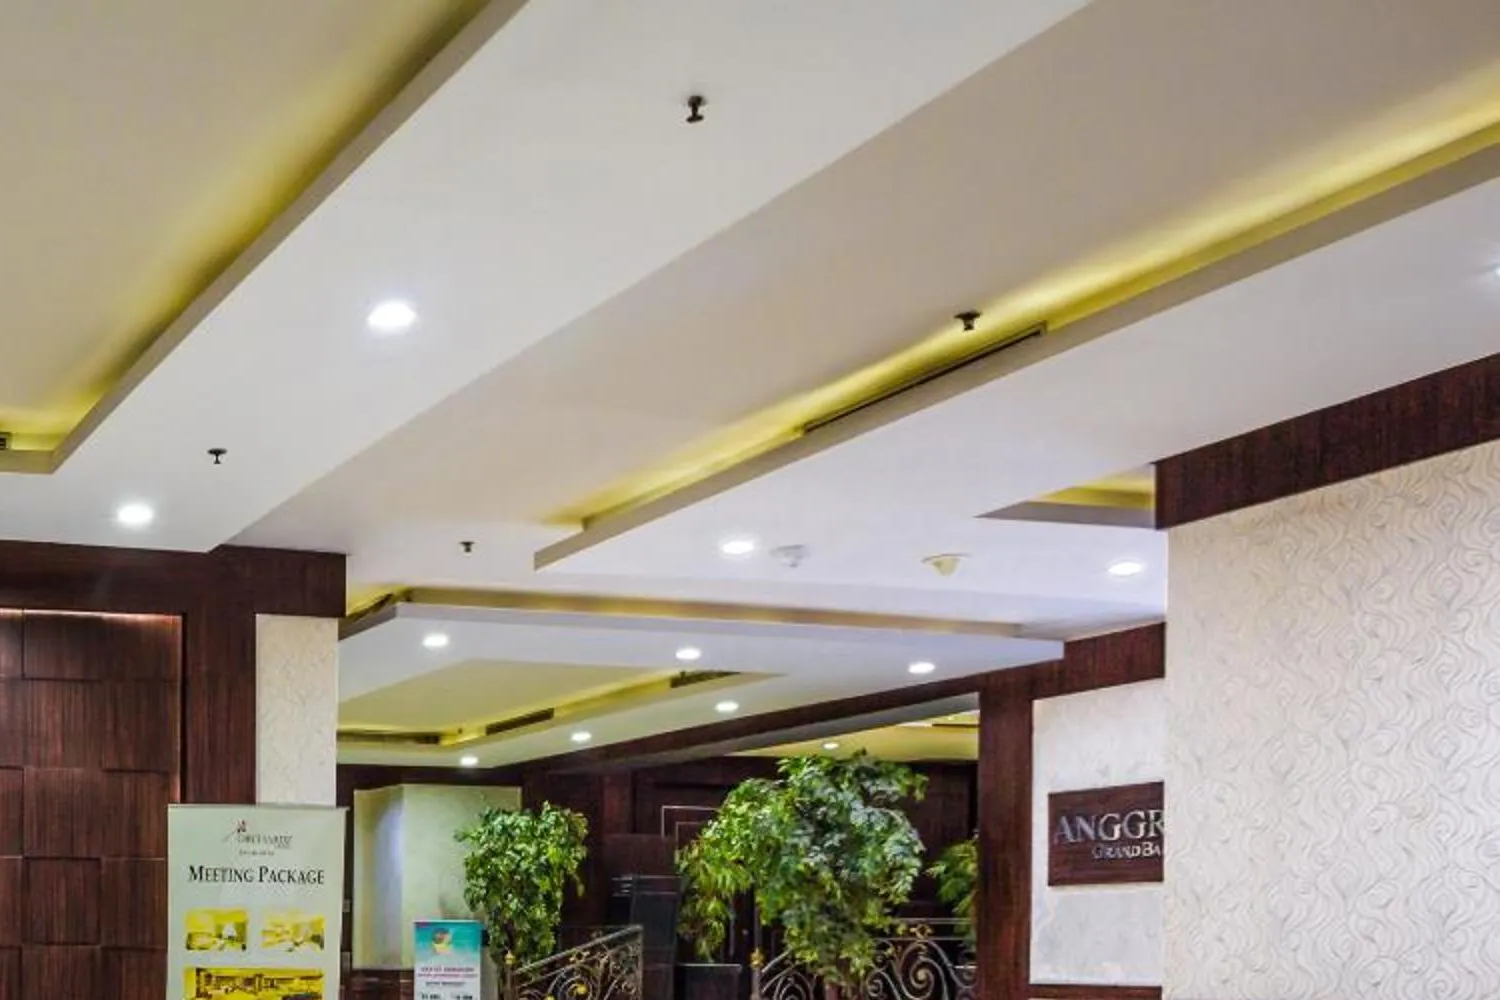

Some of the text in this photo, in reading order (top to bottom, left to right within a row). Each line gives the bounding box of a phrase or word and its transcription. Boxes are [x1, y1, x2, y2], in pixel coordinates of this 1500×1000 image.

[1092, 844, 1141, 860] GRAND
[188, 865, 325, 885] MEETING PACKAGE
